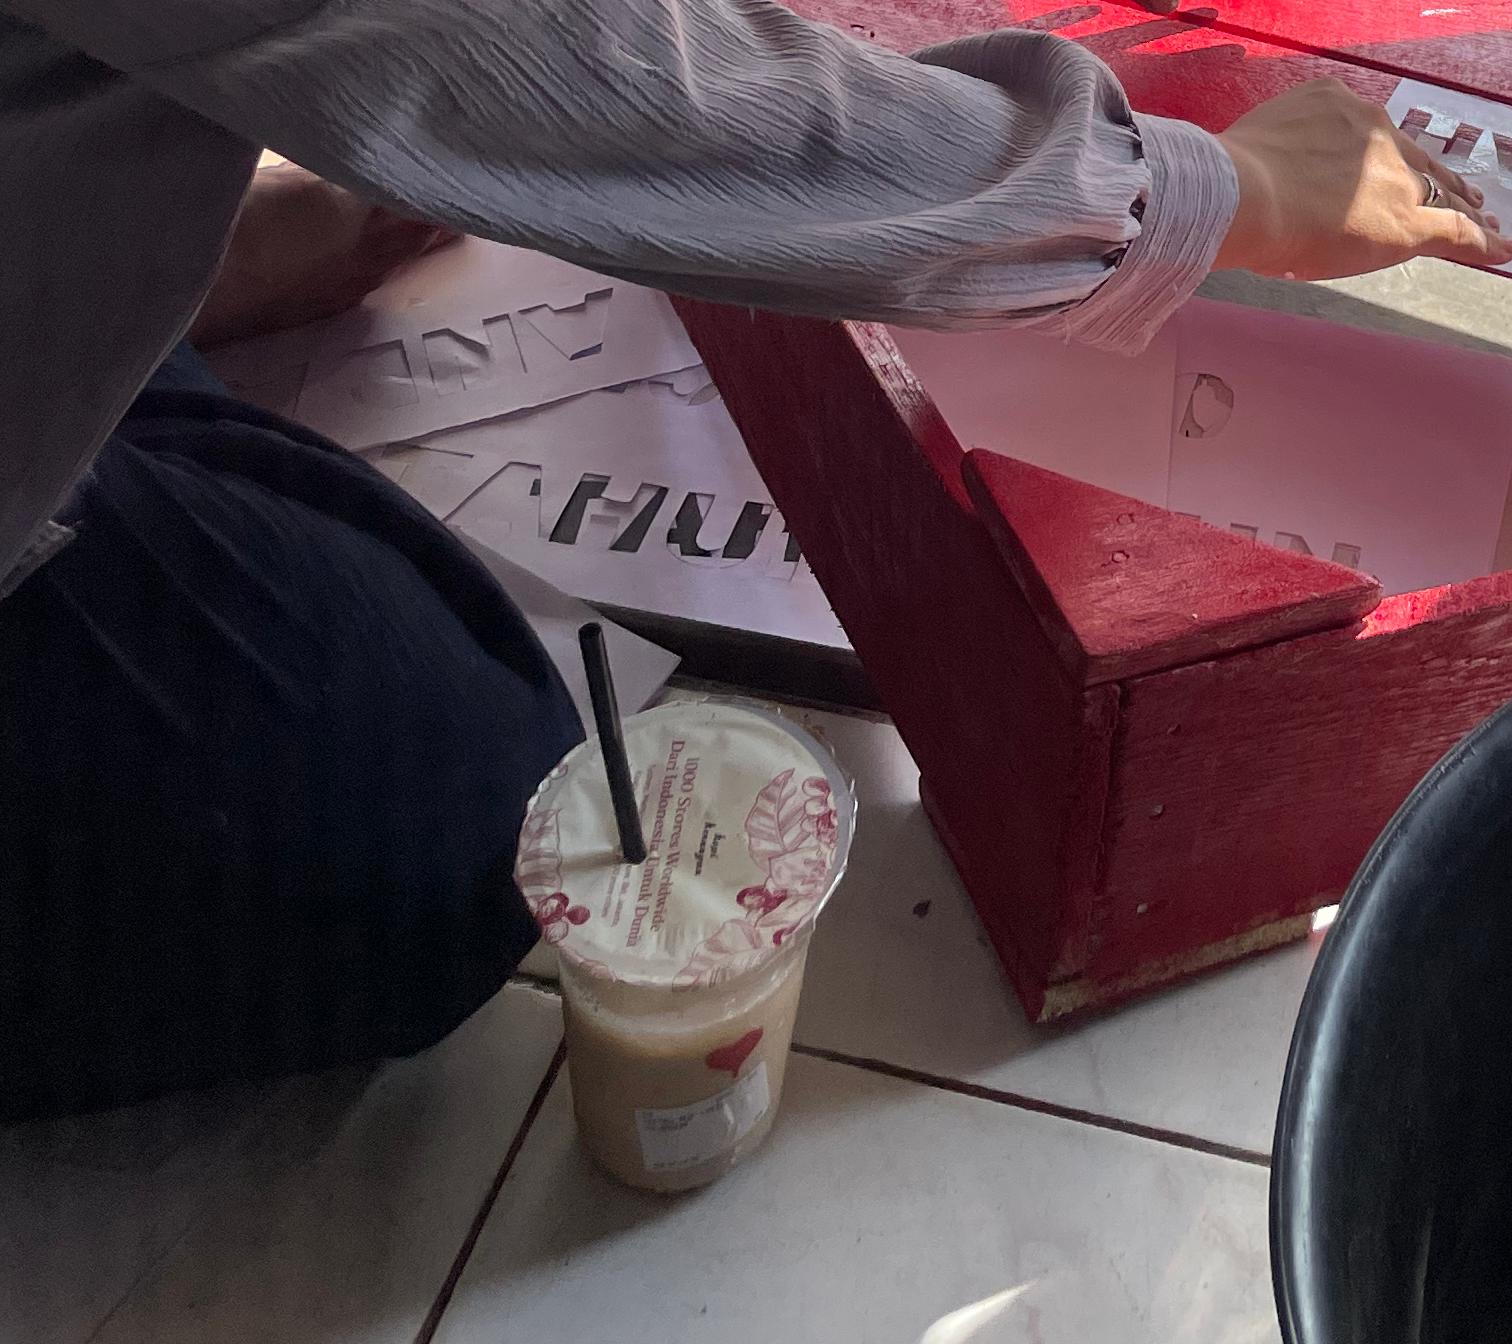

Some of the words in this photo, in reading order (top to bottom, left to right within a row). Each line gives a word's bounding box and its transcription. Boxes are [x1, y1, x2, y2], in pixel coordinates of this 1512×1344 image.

[666, 740, 686, 772] Dari
[680, 757, 700, 793] 1000
[649, 774, 678, 853] Indonesia
[669, 797, 691, 849] Stores
[637, 857, 661, 903] Untuk
[649, 851, 681, 933] Worldwide
[626, 906, 650, 949] Dunia
